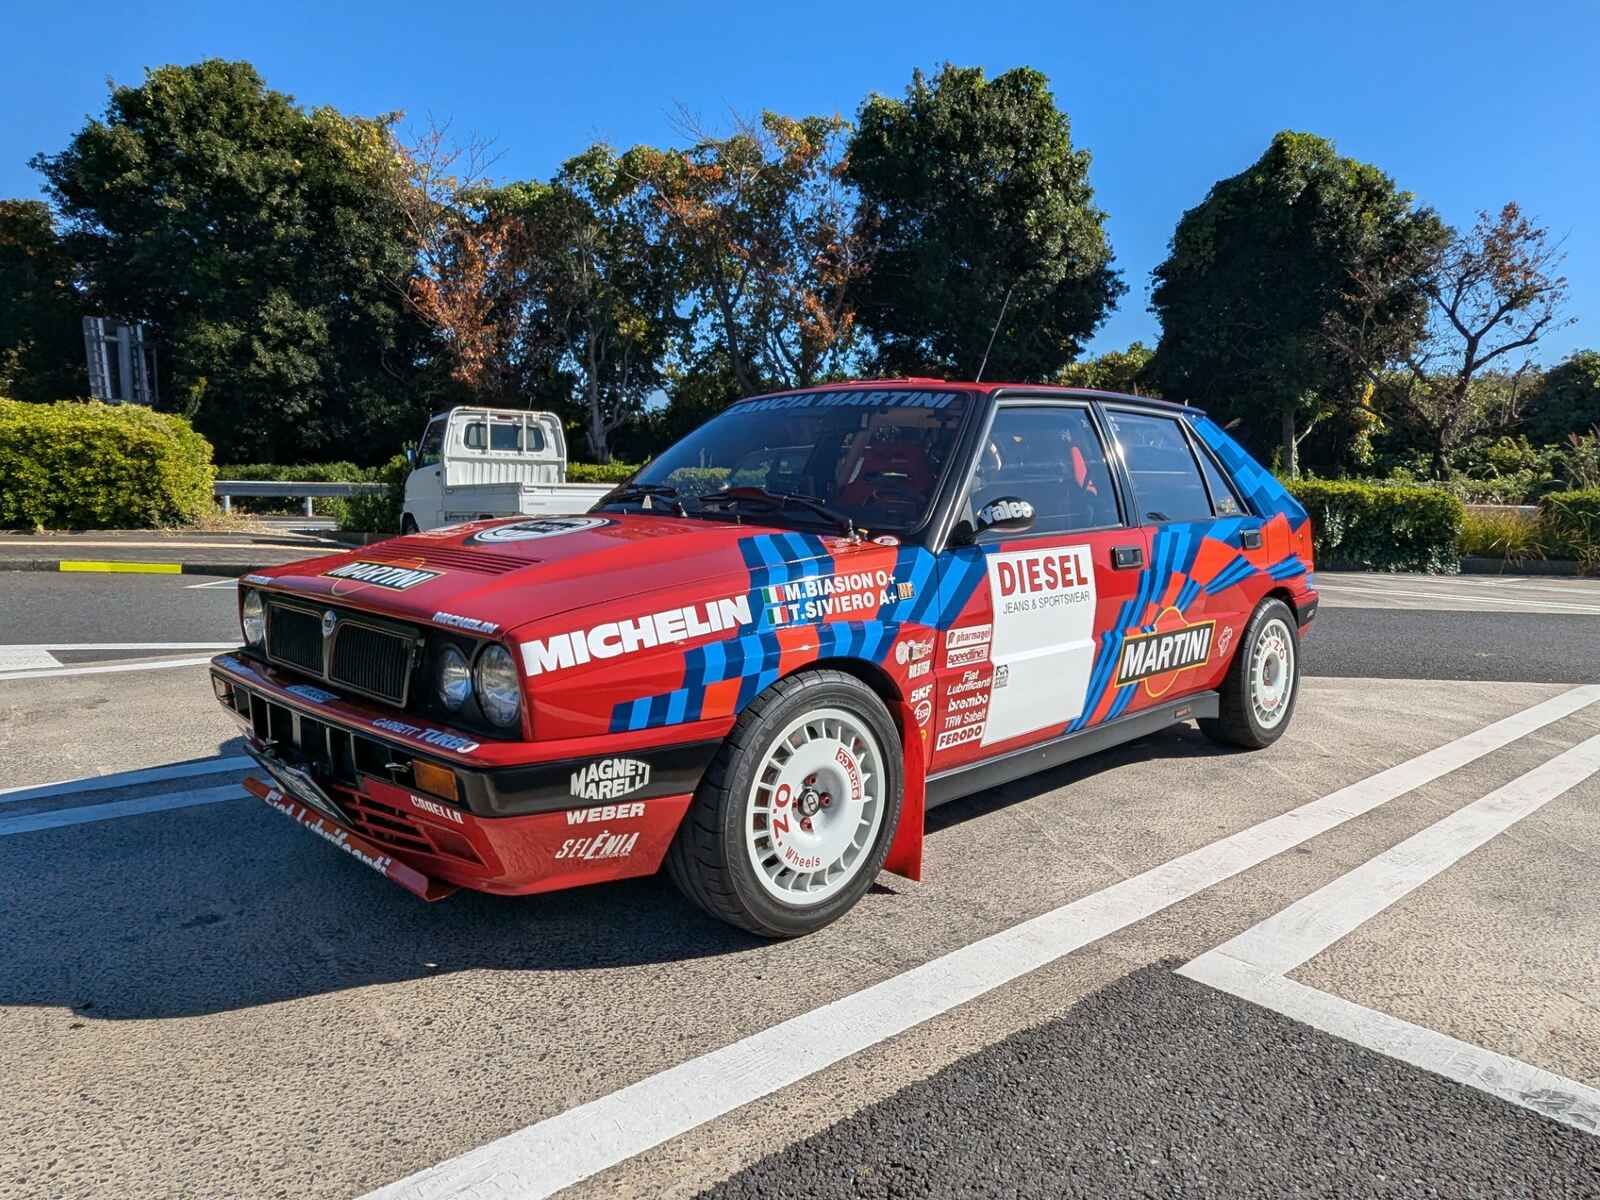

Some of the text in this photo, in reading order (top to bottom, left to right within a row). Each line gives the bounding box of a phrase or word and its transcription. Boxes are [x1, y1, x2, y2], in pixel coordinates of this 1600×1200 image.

[816, 391, 957, 409] MARTINI
[327, 561, 437, 588] MARTINI
[784, 572, 873, 602] M.BIASION
[997, 554, 1089, 597] DIESEL
[788, 591, 875, 622] T.SIVIERO
[1003, 590, 1090, 615] JEANS & SPORTSWEAR
[432, 611, 500, 634] MICHELIN
[519, 594, 753, 677] MICHELIN
[1120, 627, 1211, 680] MARTINI
[962, 669, 980, 683] Fiat
[911, 684, 933, 703] SKF
[947, 692, 989, 713] brembo
[945, 715, 963, 729] TRW
[416, 728, 480, 754] TURBO
[939, 726, 982, 746] FERODO
[570, 758, 651, 787] MAGNETI
[570, 772, 651, 800] MARELLI
[566, 801, 645, 826] WEBER
[784, 846, 821, 868] Wheels
